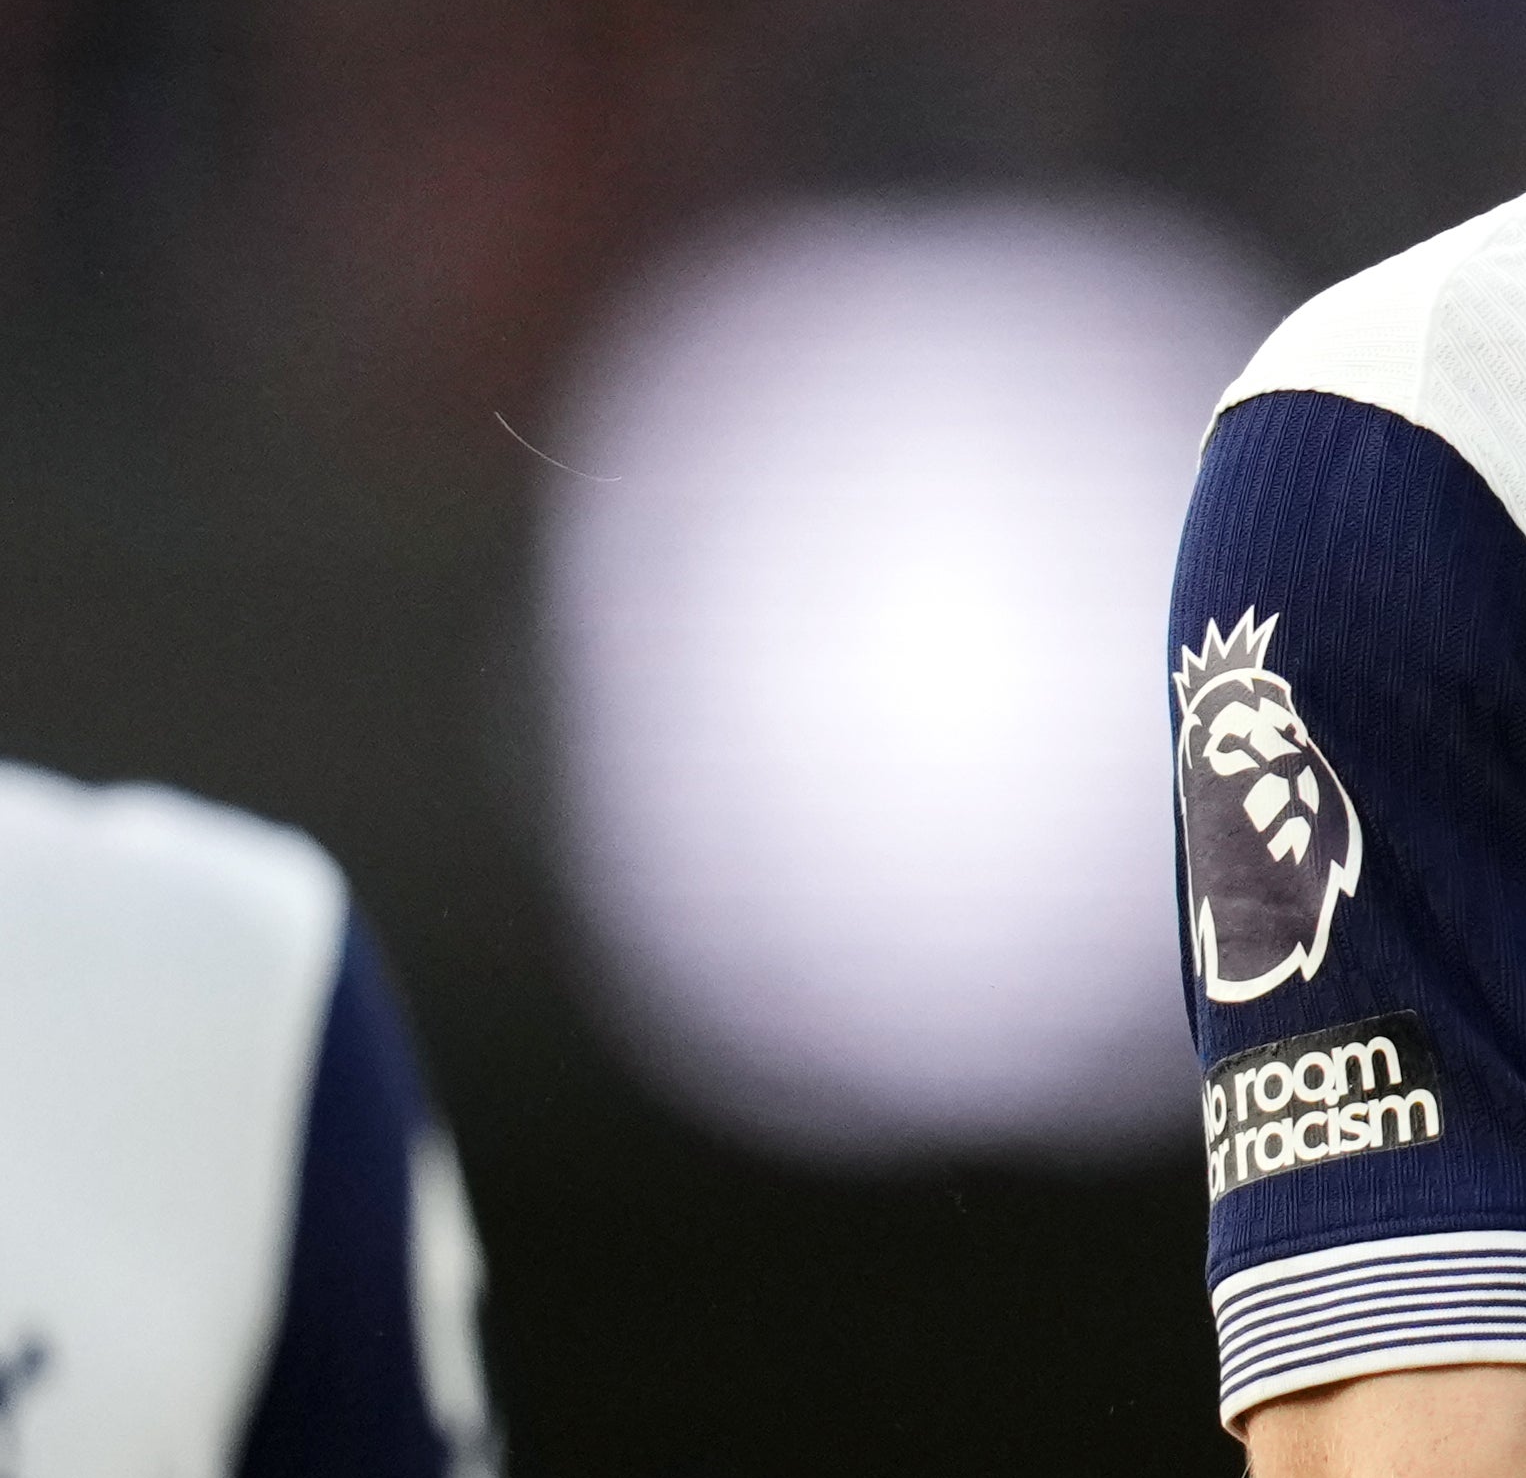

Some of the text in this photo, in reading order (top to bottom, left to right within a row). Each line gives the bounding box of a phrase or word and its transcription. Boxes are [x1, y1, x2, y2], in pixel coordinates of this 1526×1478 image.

[1235, 1036, 1403, 1122] room
[1208, 1088, 1440, 1203] or racism
